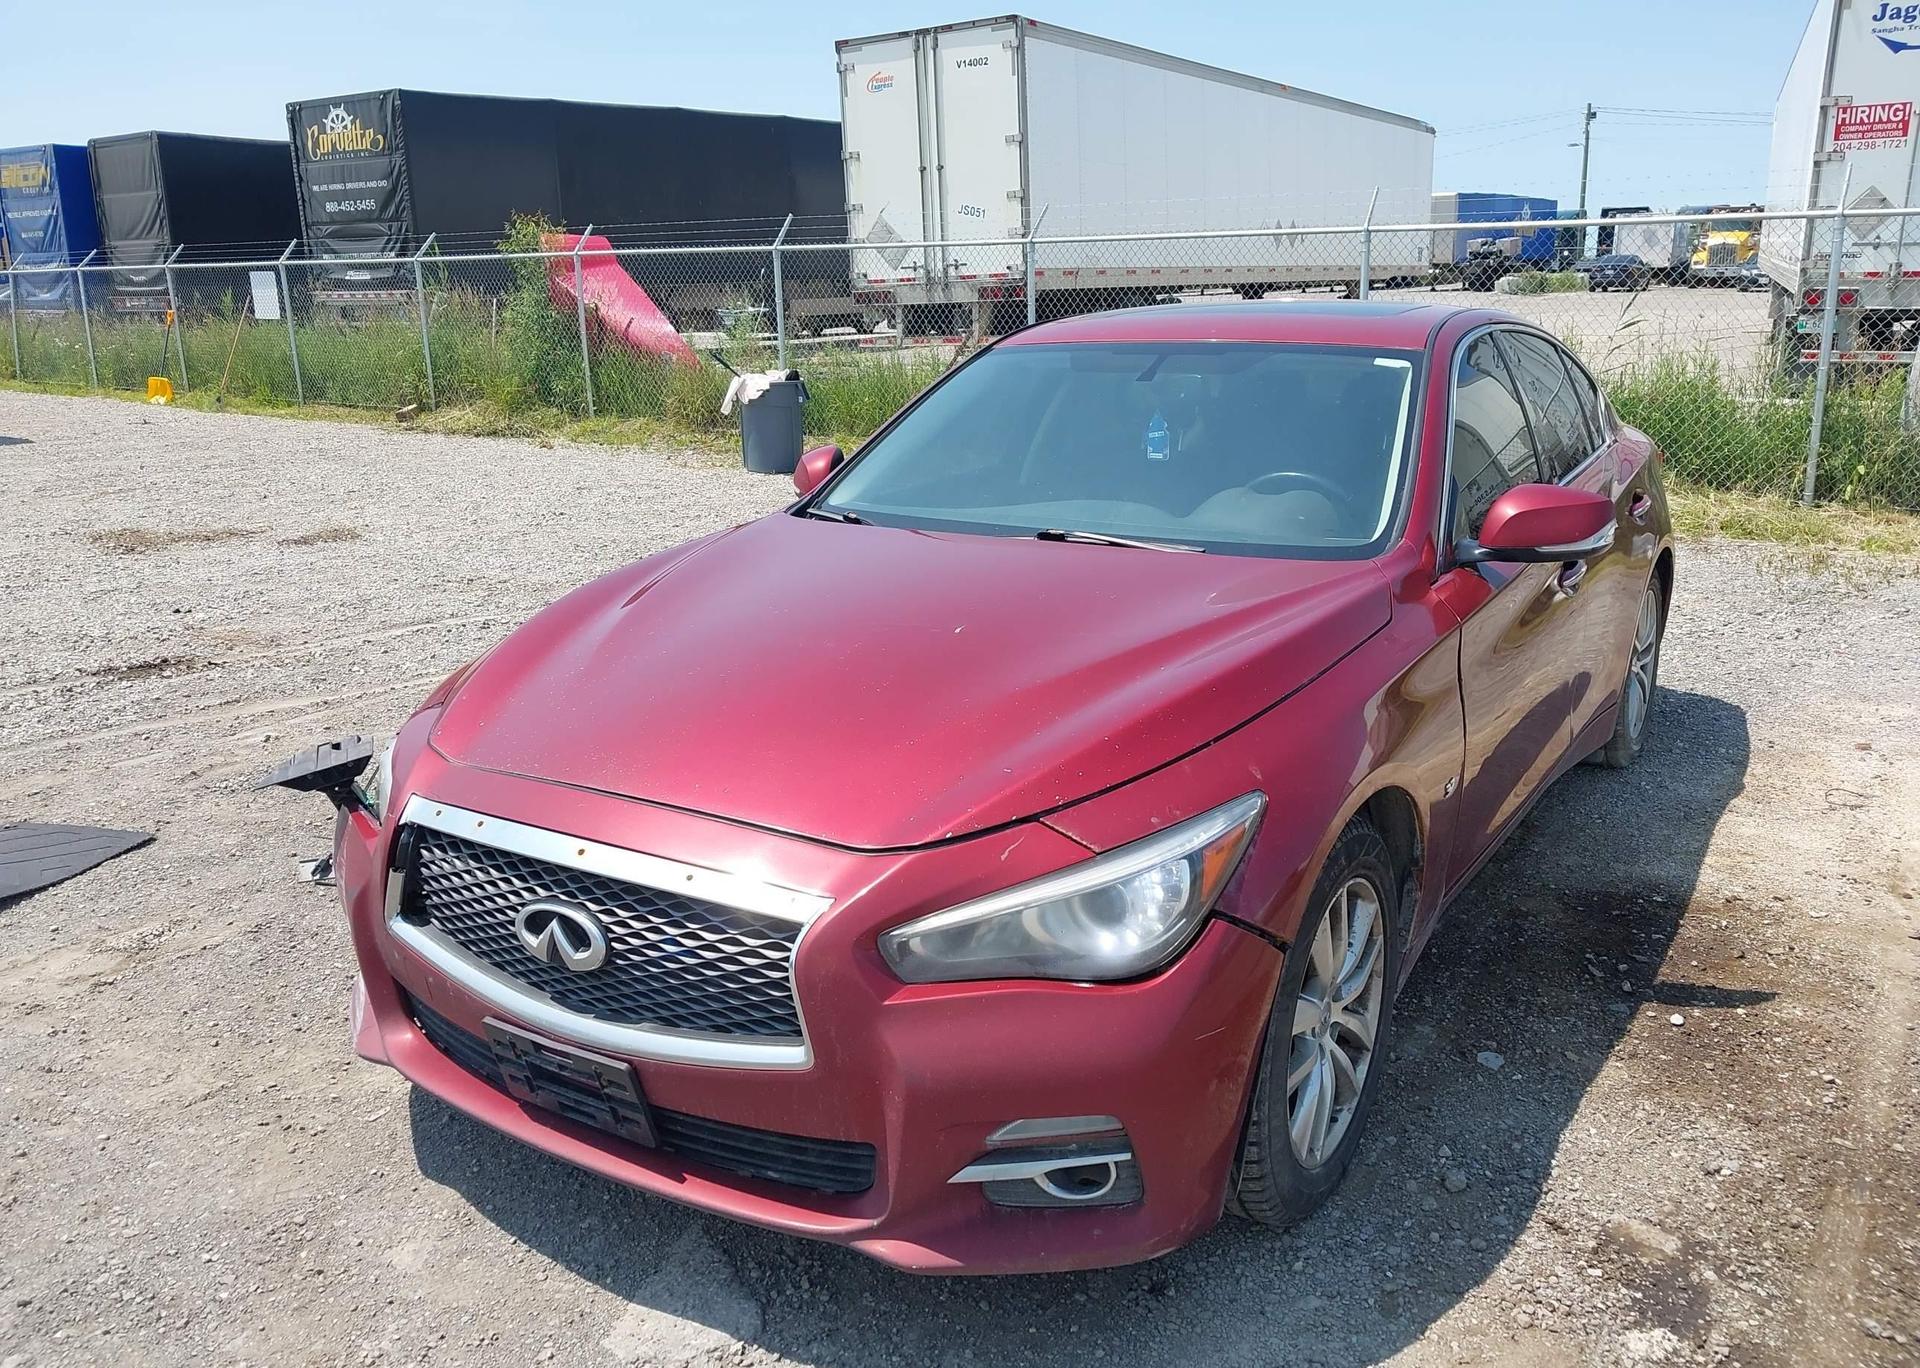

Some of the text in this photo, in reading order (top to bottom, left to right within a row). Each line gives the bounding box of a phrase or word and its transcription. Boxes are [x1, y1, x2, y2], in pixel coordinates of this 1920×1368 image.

[1872, 2, 1920, 23] Jag
[956, 56, 989, 69] V14002
[1837, 103, 1911, 125] HIRING!
[1838, 129, 1903, 140] OWNER OPERATORS
[1840, 124, 1872, 133] COMPANY
[1873, 122, 1898, 131] DRIVER
[307, 118, 384, 161] Corvette
[1832, 139, 1908, 152] 204-298-1721
[325, 199, 376, 213] 888-452-5455
[957, 204, 986, 219] JS051
